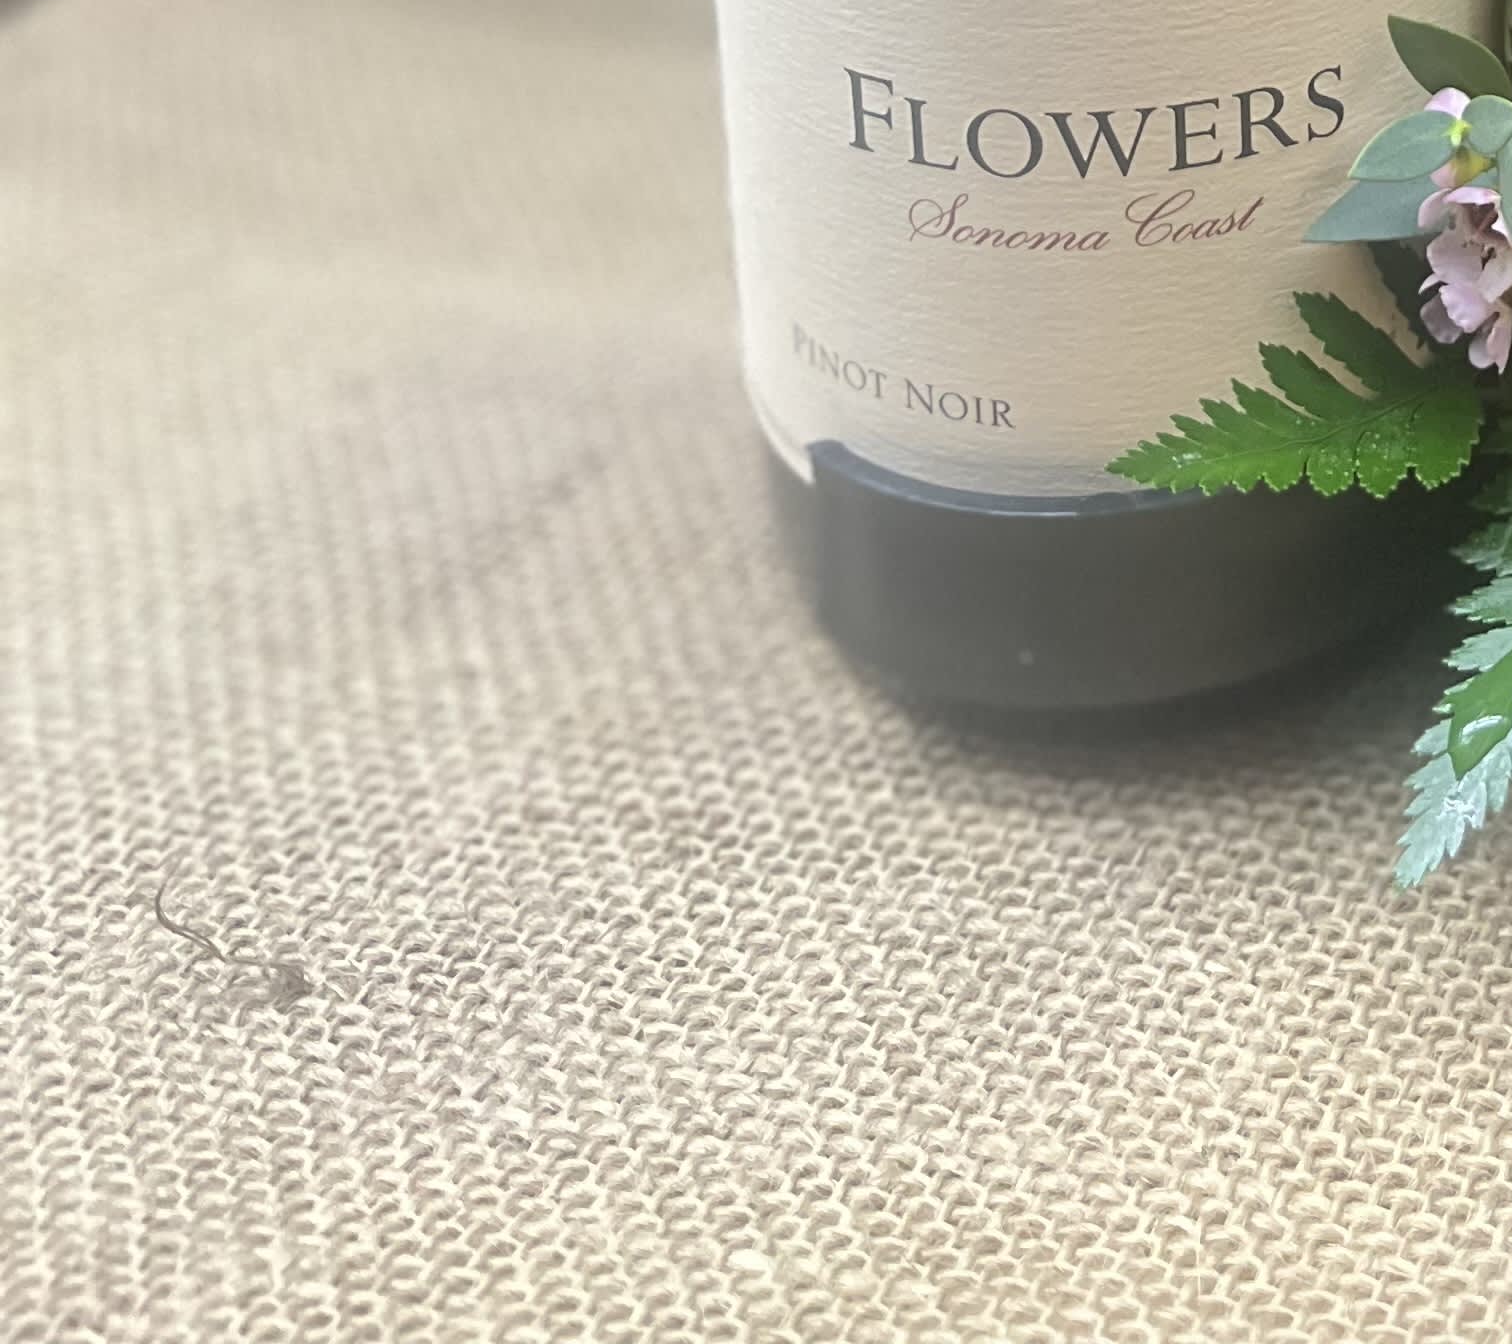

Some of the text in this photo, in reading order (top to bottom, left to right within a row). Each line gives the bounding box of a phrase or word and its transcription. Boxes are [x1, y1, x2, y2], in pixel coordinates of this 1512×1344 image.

[844, 65, 1345, 179] FLOWERS
[907, 188, 1265, 253] Sonoma Coast
[791, 322, 1017, 430] PINOT NOIR
